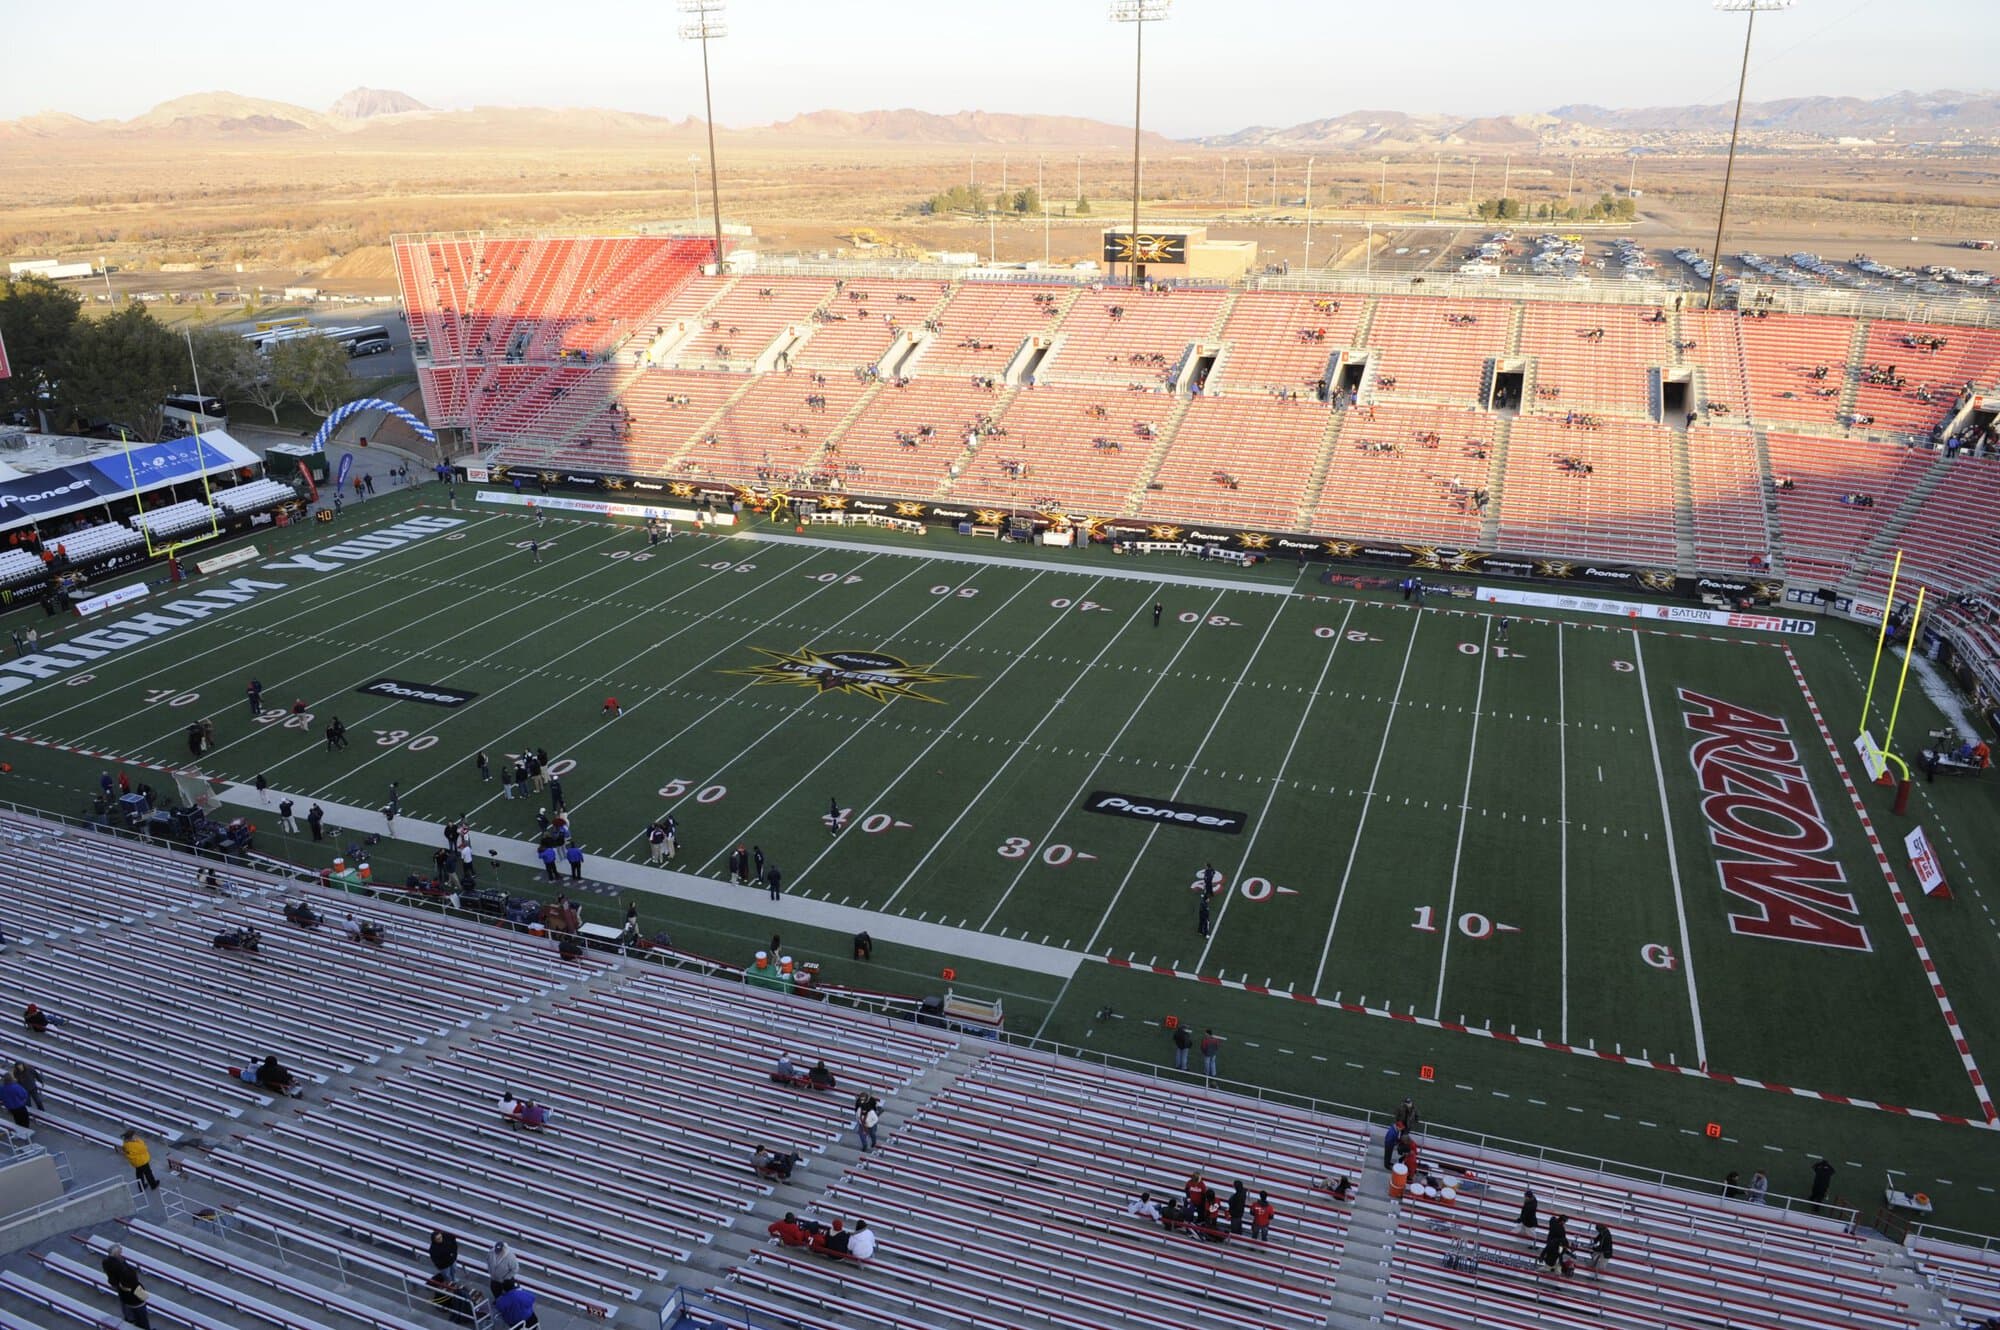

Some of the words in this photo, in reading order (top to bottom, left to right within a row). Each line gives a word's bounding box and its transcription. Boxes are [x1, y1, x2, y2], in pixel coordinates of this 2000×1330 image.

[0, 478, 92, 508] Pioneer
[317, 510, 332, 521] 40
[262, 516, 468, 572] YOUNG
[1278, 539, 1320, 550] Pioneer
[1585, 568, 1631, 579] Pioneer
[1699, 579, 1747, 591] Pioneer
[1671, 606, 1712, 621] SATURN
[831, 654, 894, 668] Pioneer
[783, 663, 827, 675] LAS
[830, 668, 904, 685] VEGAS
[368, 683, 465, 703] Pioneer
[658, 778, 728, 803] 50
[1096, 797, 1236, 826] Pioneer
[1677, 687, 1873, 952] ARIZONA
[997, 836, 1074, 866] 30
[1411, 905, 1493, 940] 10
[1640, 943, 1678, 970] G
